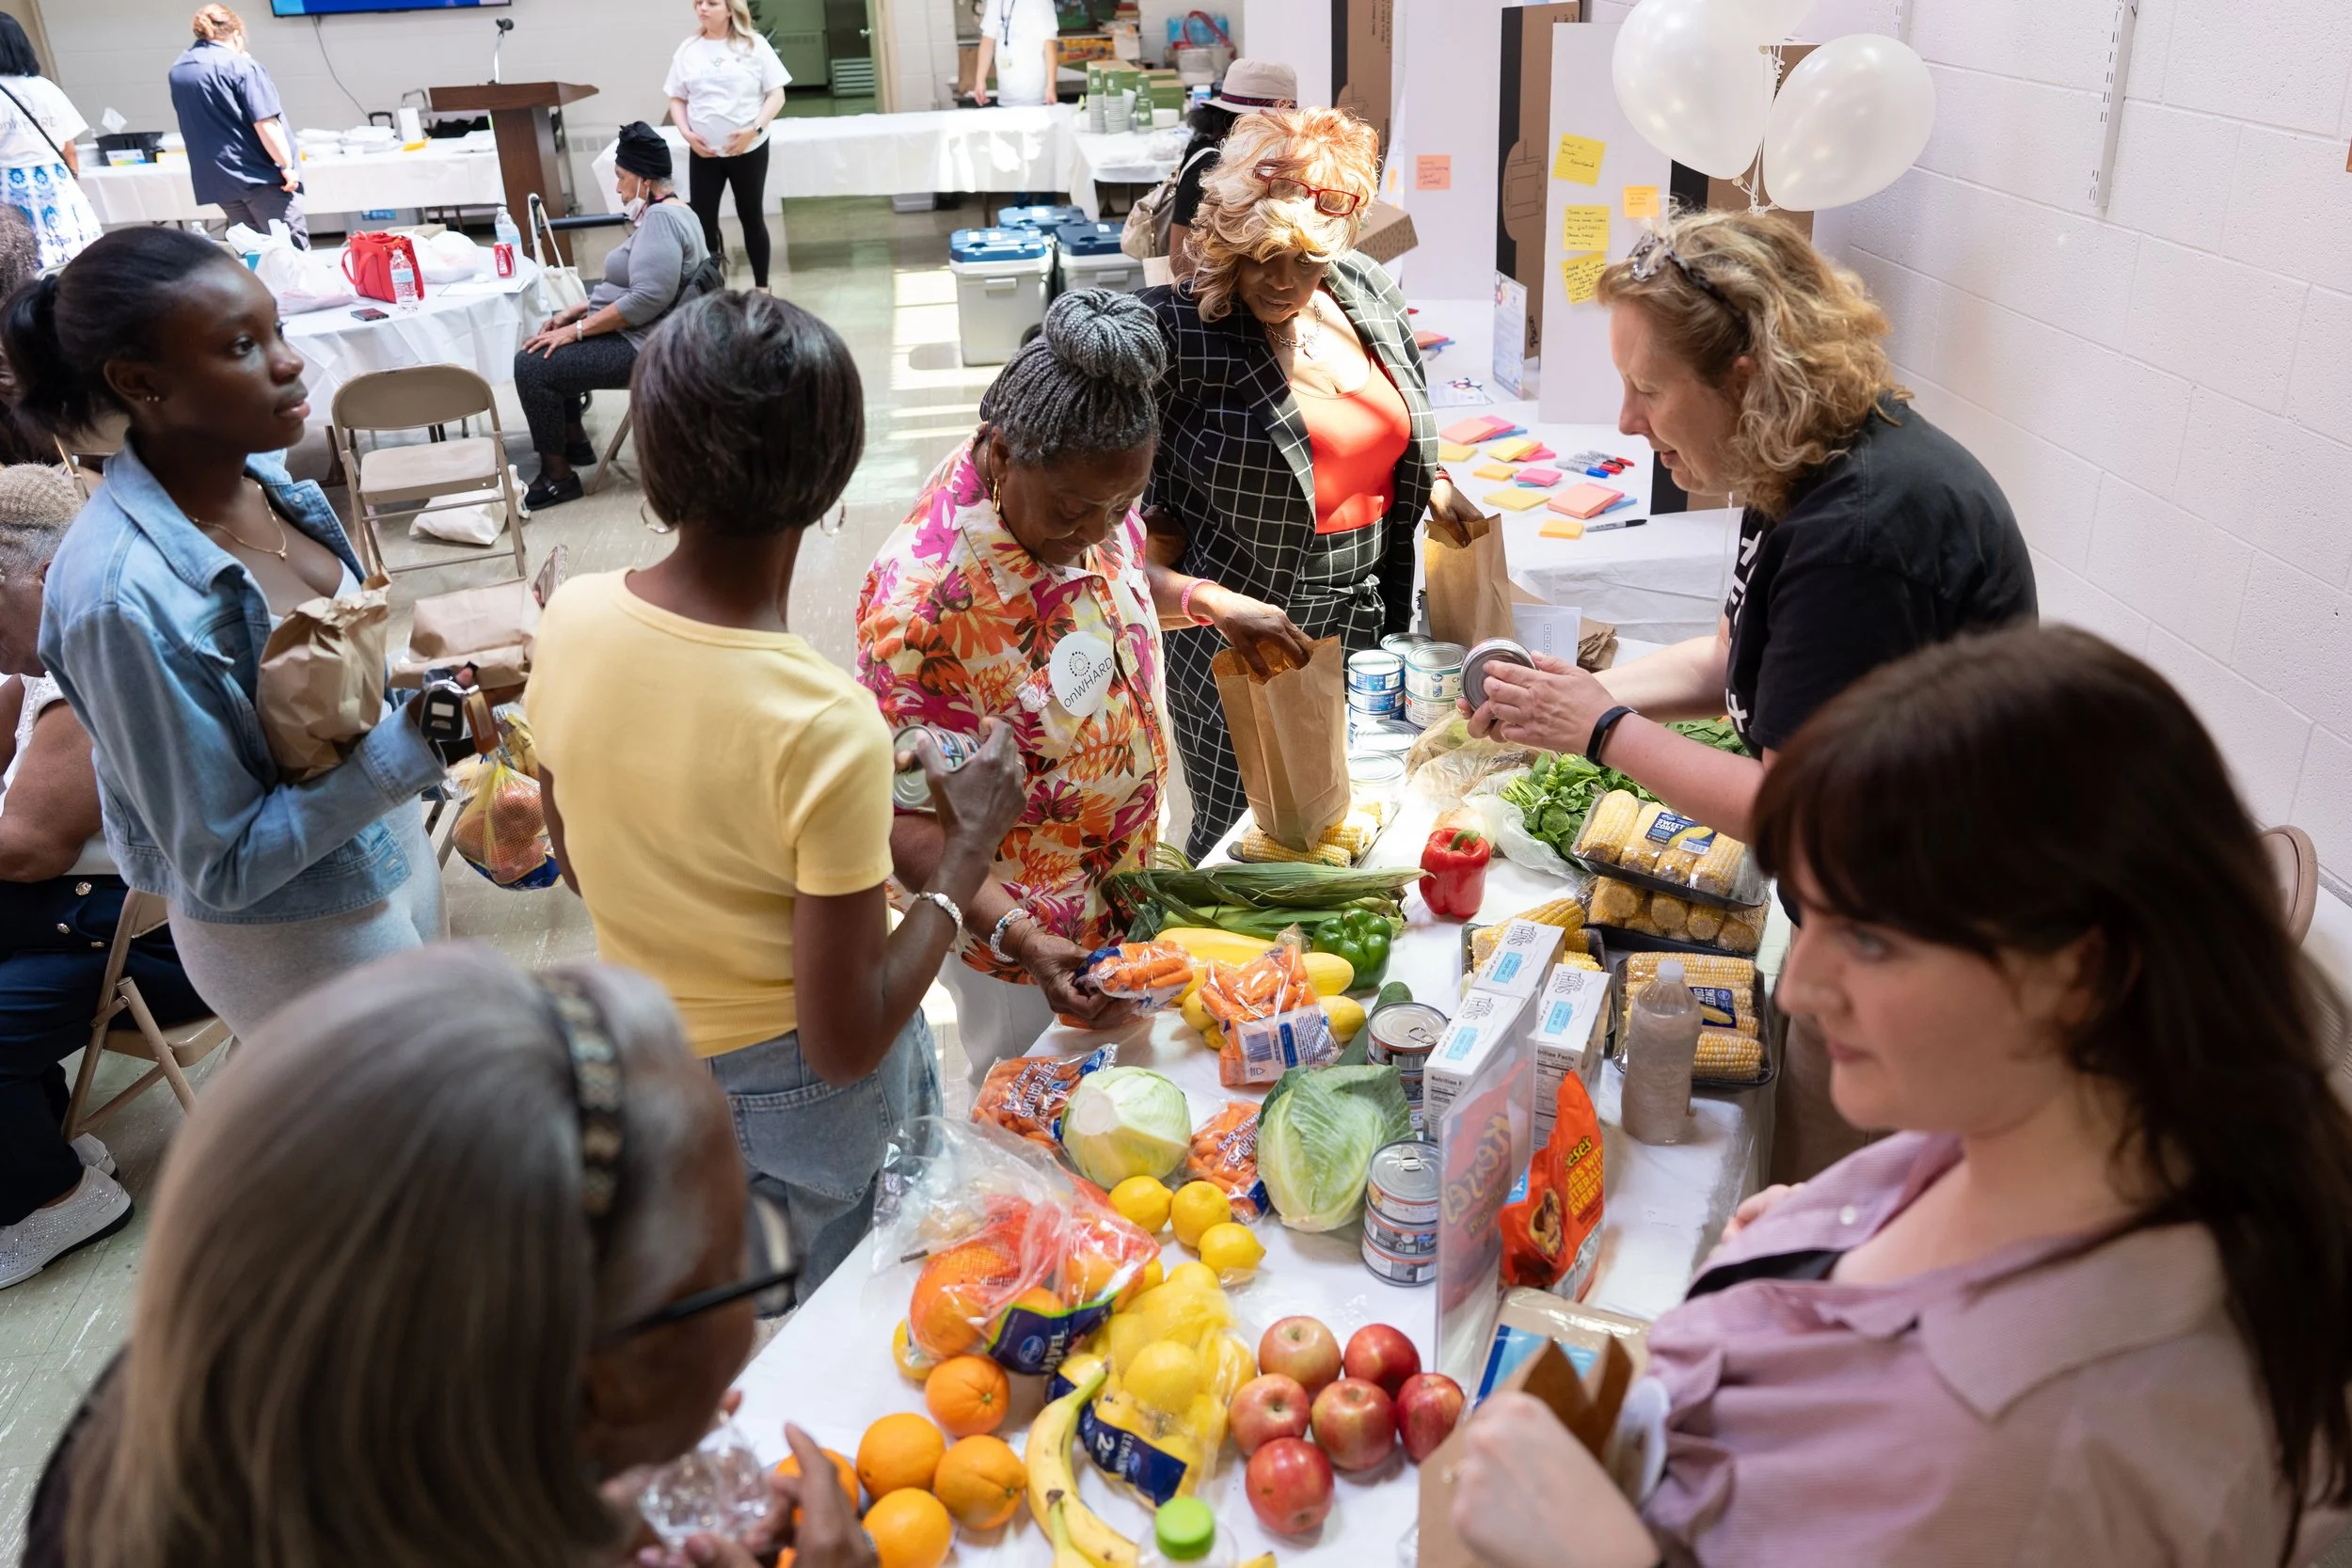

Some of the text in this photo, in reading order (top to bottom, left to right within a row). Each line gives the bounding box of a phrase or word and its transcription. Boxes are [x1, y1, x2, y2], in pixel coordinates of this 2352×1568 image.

[1064, 657, 1113, 708] onWHARD
[1654, 823, 1677, 832] CORN
[1657, 818, 1686, 830] SWEET
[1705, 988, 1716, 1006] SWEET
[1218, 1131, 1242, 1151] Bag
[1096, 1432, 1116, 1452] 2
